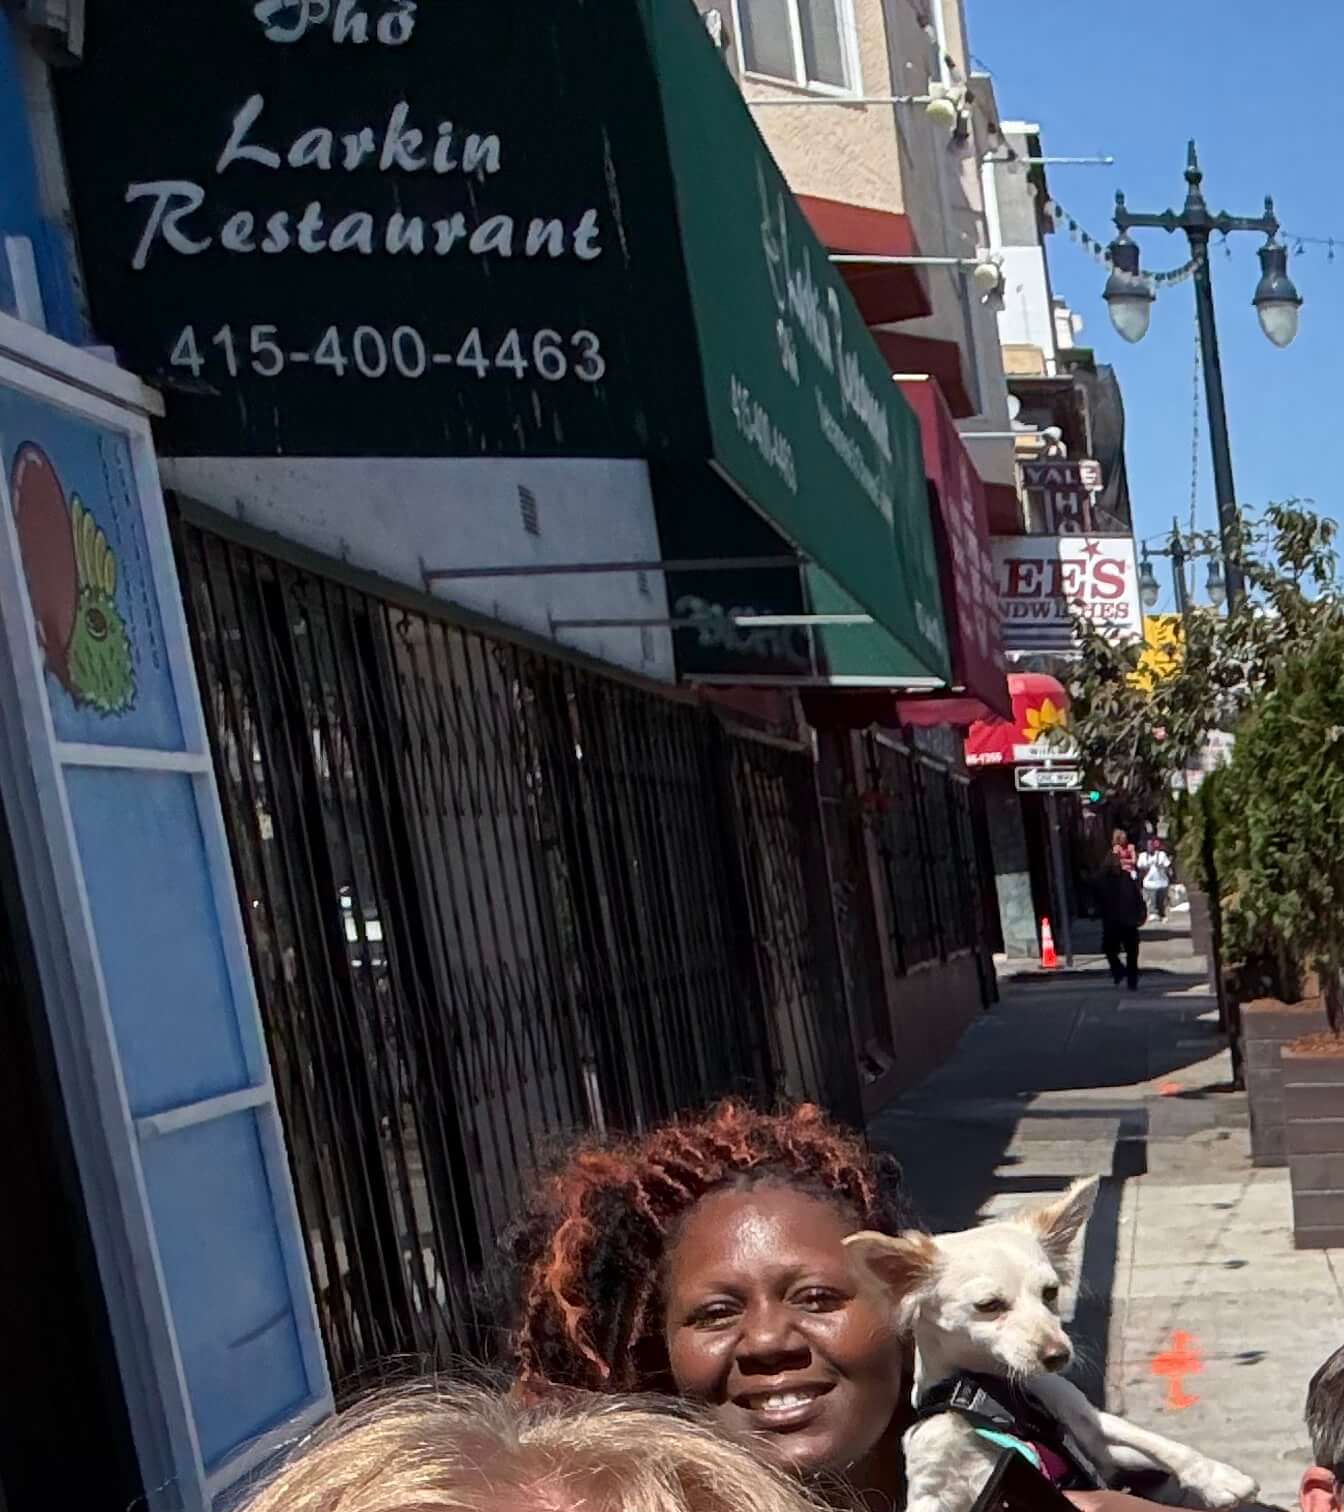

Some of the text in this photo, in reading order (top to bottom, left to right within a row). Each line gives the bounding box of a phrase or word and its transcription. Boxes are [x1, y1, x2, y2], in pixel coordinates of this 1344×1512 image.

[216, 93, 501, 174] Larkin
[125, 180, 602, 270] Restaurant
[170, 324, 606, 382] 415-400-4463
[1024, 466, 1099, 485] YALE
